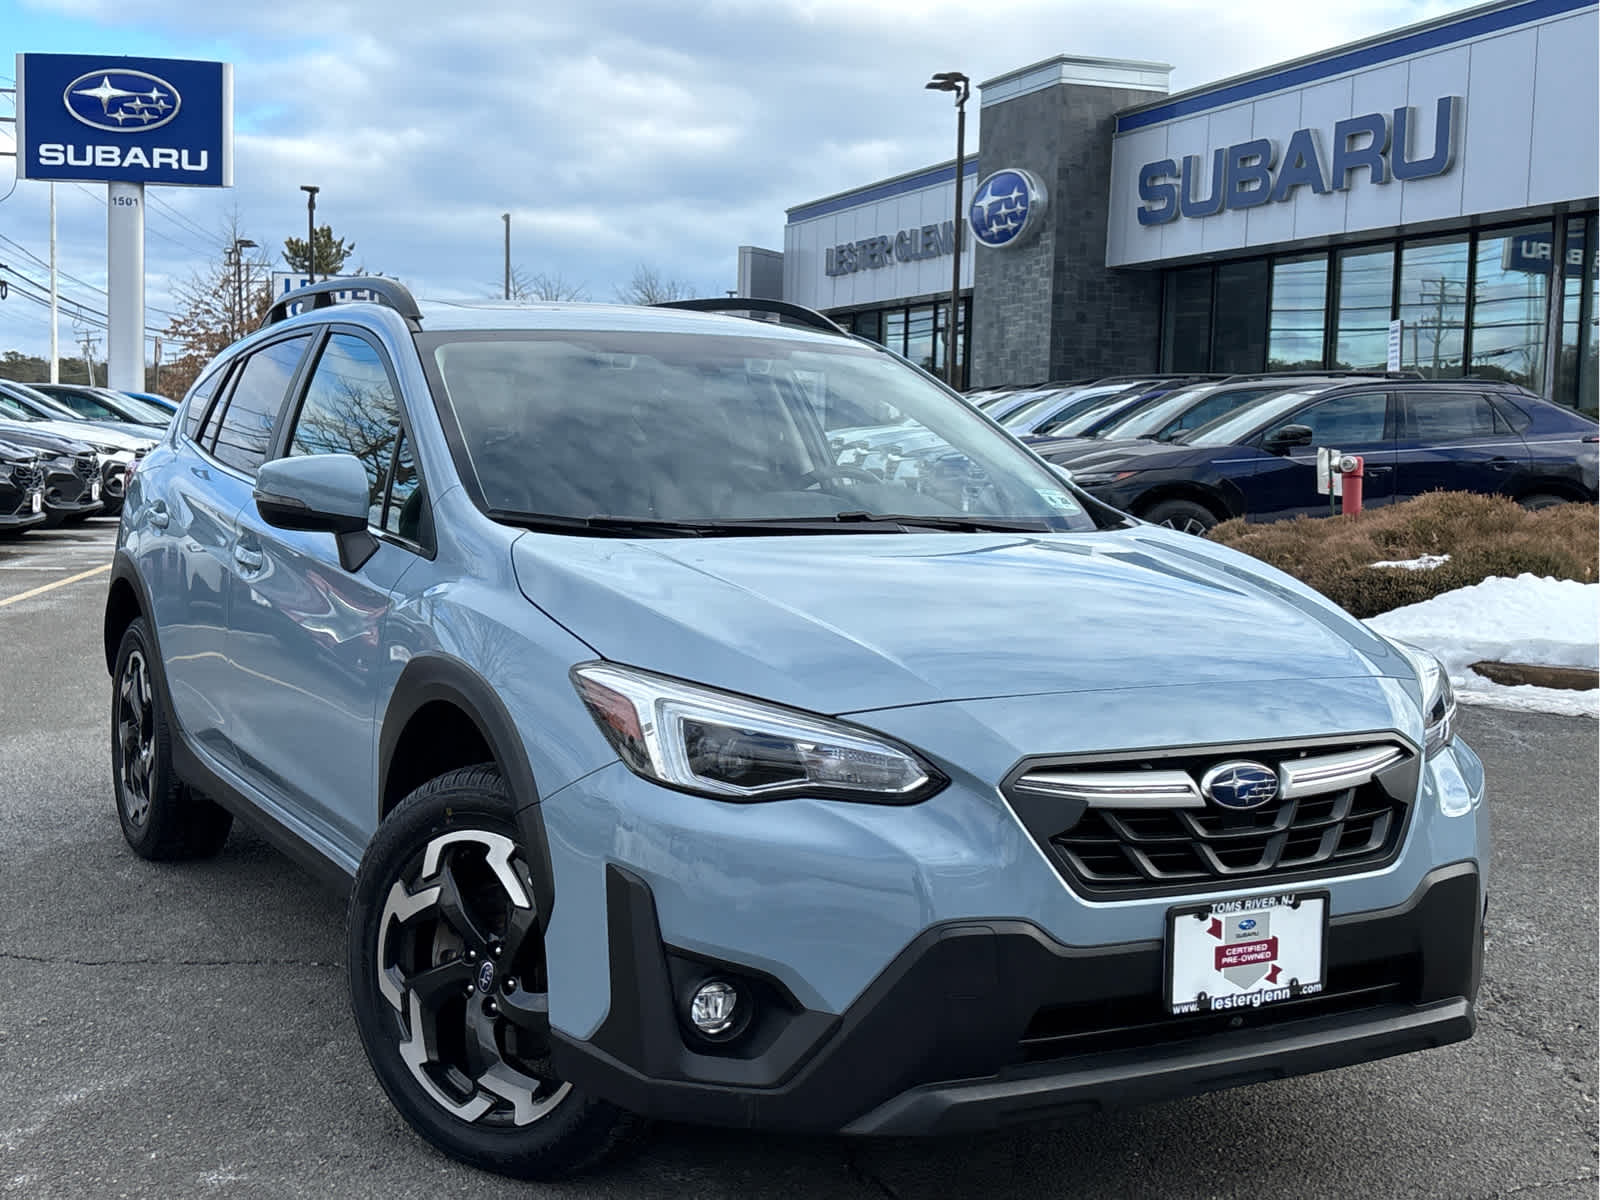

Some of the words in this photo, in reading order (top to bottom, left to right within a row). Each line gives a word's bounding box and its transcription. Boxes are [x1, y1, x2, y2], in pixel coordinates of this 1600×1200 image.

[39, 143, 208, 172] SUBARU
[1137, 96, 1461, 226] SUBARU
[112, 196, 138, 206] 1501
[825, 235, 891, 276] LESTER
[1210, 901, 1242, 914] TOMS
[1281, 894, 1295, 906] NJ
[1221, 951, 1272, 964] PRE-OWNED
[1225, 943, 1268, 956] CERTIFIED
[1172, 1003, 1200, 1015] www.
[1210, 988, 1291, 1010] lesterglenn
